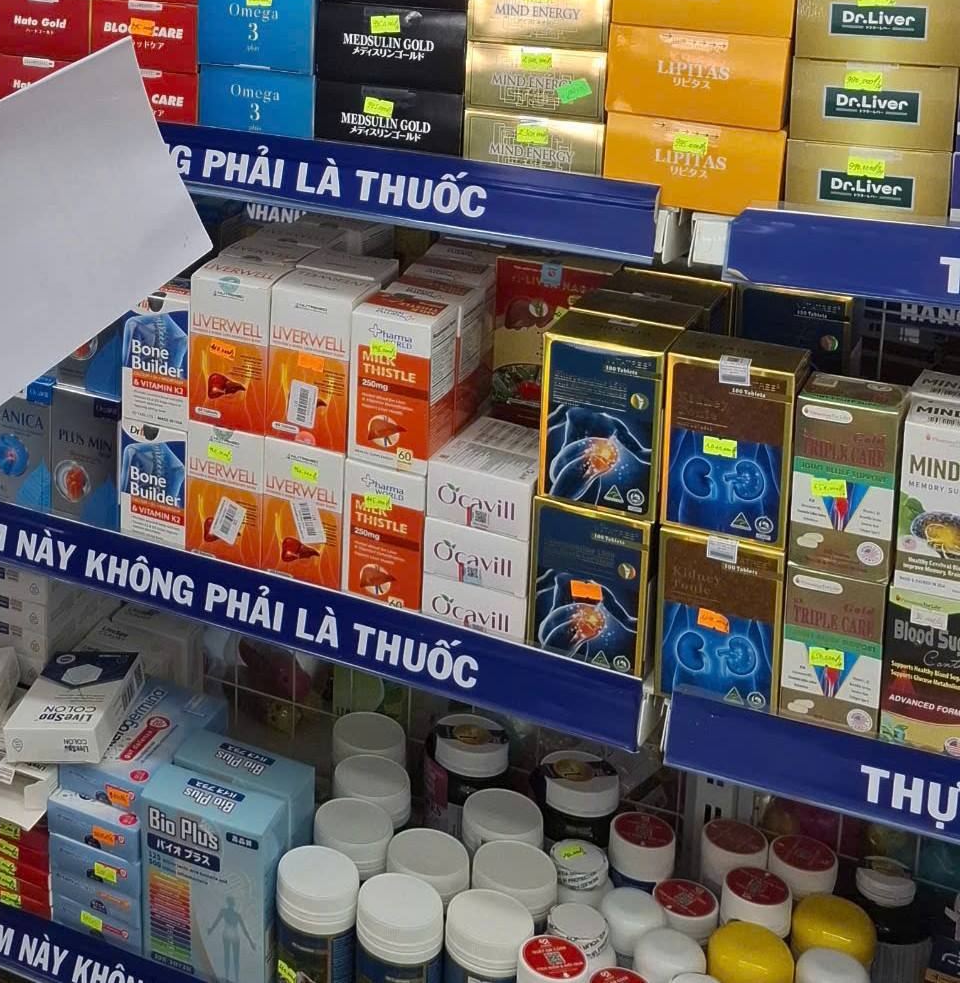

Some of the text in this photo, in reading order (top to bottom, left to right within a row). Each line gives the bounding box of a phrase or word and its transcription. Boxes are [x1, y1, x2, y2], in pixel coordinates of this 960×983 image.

[229, 3, 279, 20] Omega
[495, 3, 580, 21] MIND ENERGY
[842, 10, 915, 27] Dr.Liver
[14, 16, 66, 30] Hato Gold
[247, 23, 259, 41] 3
[153, 28, 184, 39] CARE
[343, 32, 435, 53] MEDSULIN GOLD
[657, 60, 729, 80] LIPITAS
[230, 83, 280, 102] Omega
[673, 78, 710, 90] リピタス
[152, 95, 184, 107] CARE
[836, 93, 908, 111] Dr.Liver
[250, 103, 260, 121] 3
[341, 112, 431, 134] MEDSULIN GOLD
[202, 145, 285, 188] PHẢI
[296, 158, 340, 197] LÀ
[356, 171, 487, 218] THUỐC
[830, 177, 902, 196] Dr.Liver
[193, 313, 262, 338] LIVERWELL
[273, 325, 345, 352] LIVERWELL
[132, 340, 169, 359] Bone
[132, 356, 183, 379] Builder
[363, 363, 416, 384] THISTLE
[617, 366, 638, 375] Tablets
[142, 381, 171, 393] VITAMIN
[173, 386, 183, 394] K2
[362, 378, 388, 392] 250mg
[743, 389, 765, 399] Tablets
[2, 408, 44, 431] ANICA
[58, 427, 113, 453] PLUS MIN
[399, 451, 410, 461] 60
[131, 466, 166, 487] Bone
[190, 457, 257, 485] LIVERWELL
[131, 481, 180, 507] Builder
[266, 476, 337, 504] LIVERWELL
[909, 480, 944, 491] MEMORY
[139, 507, 168, 520] VITAMIN
[170, 516, 180, 524] K2
[355, 512, 408, 534] THISTLE
[354, 527, 380, 540] 250mg
[605, 535, 625, 545] Tablets
[737, 565, 757, 575] Tablets
[17, 530, 77, 570] NÀY
[85, 550, 194, 605] KHÔNG
[205, 585, 283, 633] PHẢI
[295, 606, 339, 648] LÀ
[353, 623, 479, 689] THUỐC
[894, 619, 934, 647] Blood
[888, 693, 934, 710] ADVANCED
[39, 713, 92, 722] LiveSpo
[215, 750, 264, 776] Bio Plus
[184, 787, 236, 814] Bio Plus
[148, 806, 219, 852] Bio Plus
[156, 839, 211, 866] バイオ プラス
[19, 934, 67, 975] NÀY
